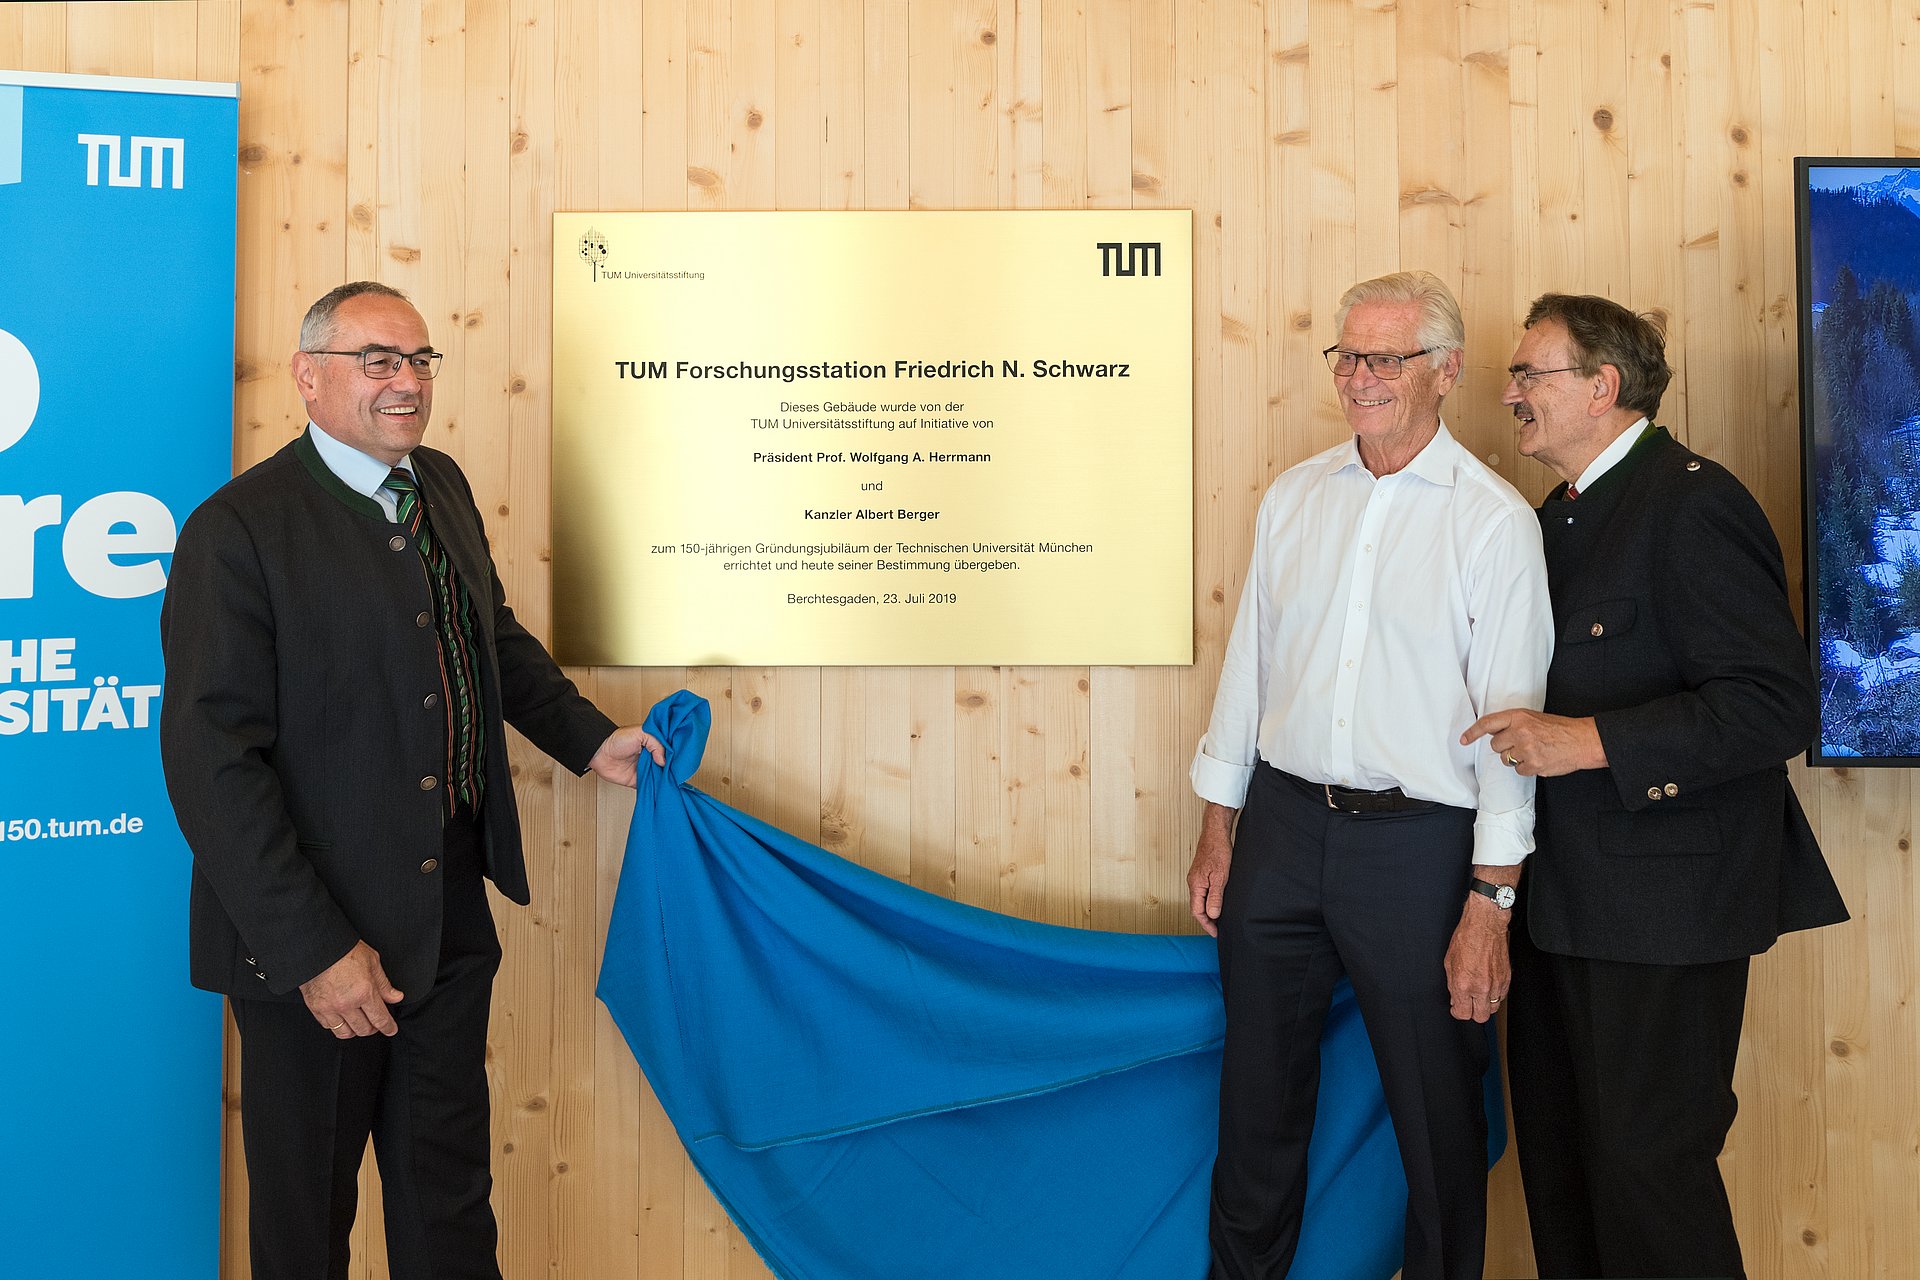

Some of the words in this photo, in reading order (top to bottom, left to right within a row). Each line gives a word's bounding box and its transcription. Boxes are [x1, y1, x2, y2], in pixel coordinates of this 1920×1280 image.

[77, 133, 184, 189] TUM
[1097, 242, 1161, 276] TUM
[601, 271, 622, 280] TUM
[624, 270, 705, 281] Universitätsstiftung
[615, 361, 667, 379] TUM
[676, 360, 887, 383] Forschungsstation
[894, 360, 994, 379] Friedrich
[1002, 360, 1025, 378] N.
[1032, 359, 1131, 378] Schwarz
[780, 401, 820, 413] Dieses
[823, 401, 877, 413] Gebäude
[880, 401, 917, 413] wurde
[920, 403, 942, 413] von
[945, 401, 965, 413] der
[751, 418, 779, 430] TUM
[782, 418, 895, 432] Universitätsstiftung
[898, 417, 918, 430] auf
[920, 417, 969, 429] Initiative
[972, 420, 994, 429] von
[753, 452, 813, 463] Präsident
[816, 451, 846, 463] Prof.
[849, 451, 909, 465] Wolfgang
[912, 452, 925, 463] A.
[929, 452, 991, 463] Herrmann
[860, 480, 883, 492] und
[804, 508, 852, 520] Kanzler
[855, 508, 894, 520] Albert
[897, 508, 941, 522] Berger
[651, 545, 676, 554] zum
[680, 542, 752, 557] 150-jährigen
[755, 542, 870, 557] Gründungsjubiläum
[873, 542, 893, 554] der
[896, 542, 969, 554] Technischen
[972, 542, 1035, 554] Universität
[1038, 541, 1093, 554] München
[723, 559, 772, 571] errichtet
[775, 559, 798, 571] und
[801, 559, 834, 571] heute
[837, 559, 874, 571] seiner
[877, 559, 951, 573] Bestimmung
[954, 559, 1021, 573] übergeben.
[787, 593, 880, 607] Berchtesgaden,
[883, 593, 901, 604] 23.
[904, 592, 925, 604] Juli
[928, 592, 957, 604] 2019
